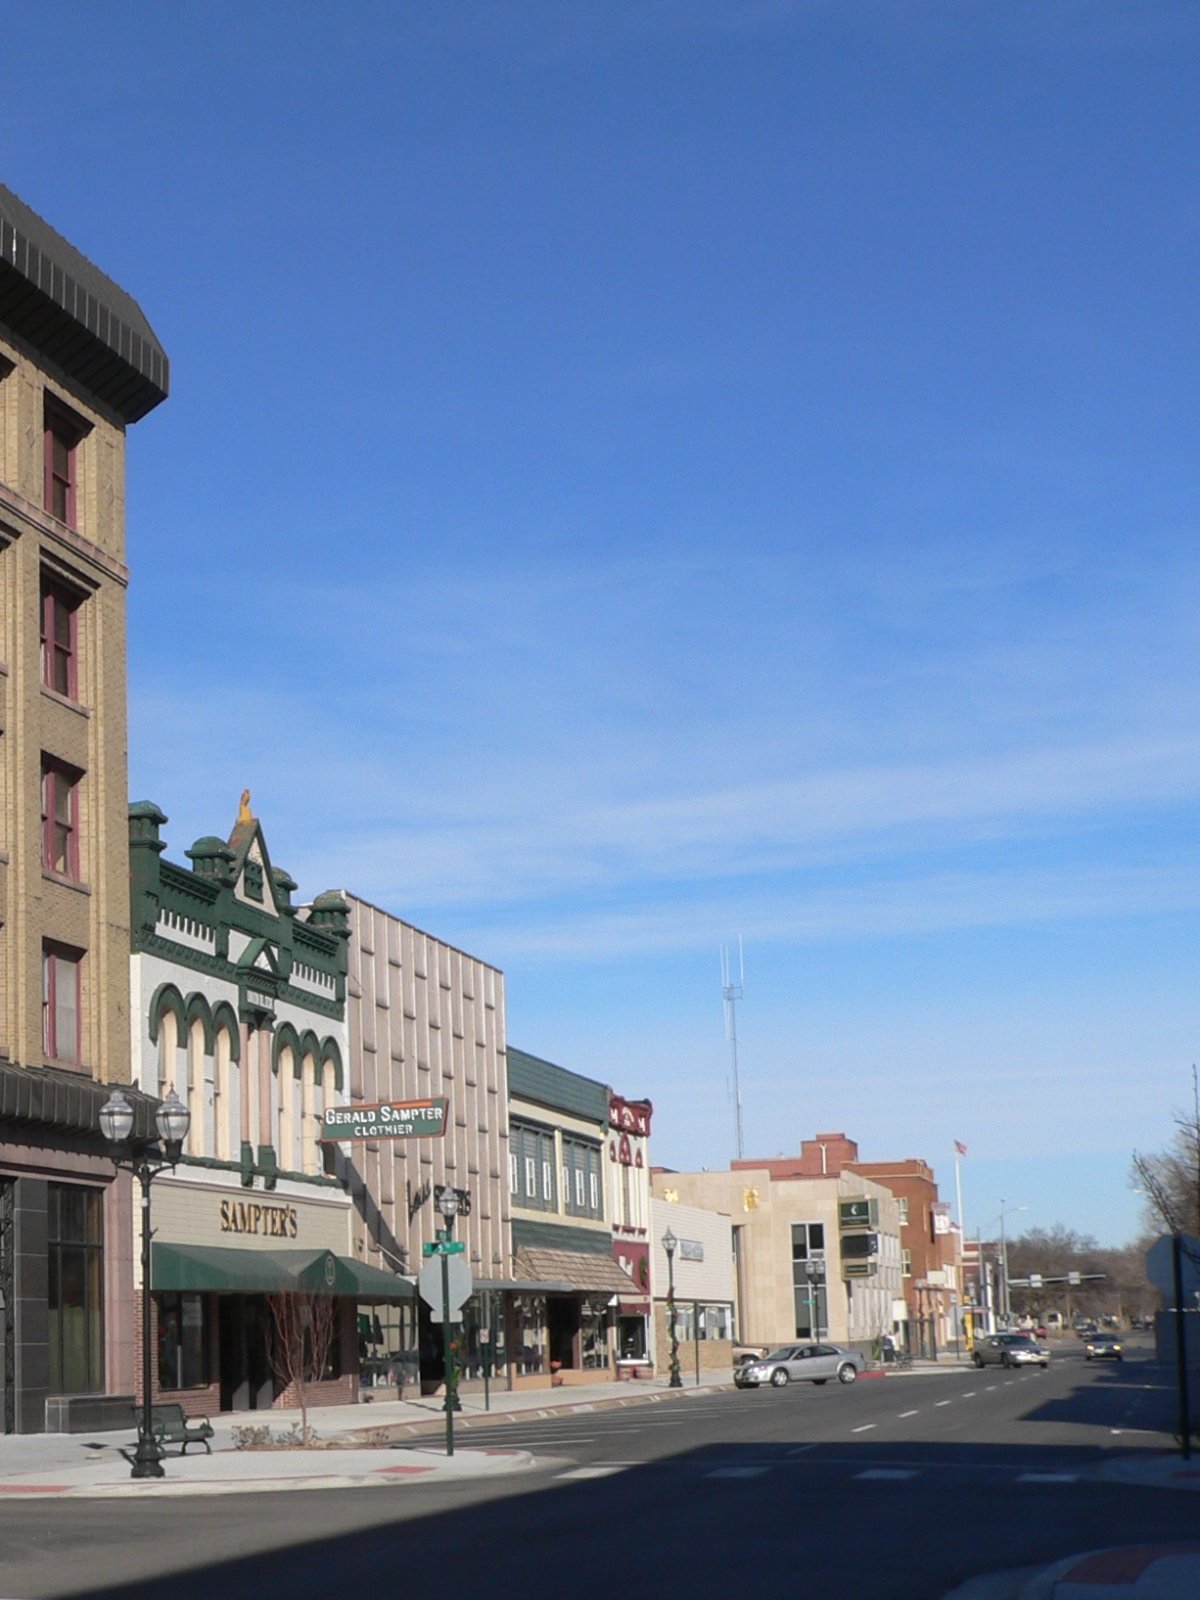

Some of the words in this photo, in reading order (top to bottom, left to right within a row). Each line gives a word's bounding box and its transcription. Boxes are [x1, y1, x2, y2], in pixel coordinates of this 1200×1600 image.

[325, 1109, 376, 1125] GERALD
[380, 1106, 443, 1122] SAMPTER
[354, 1124, 413, 1136] CLOTHIER
[220, 1199, 298, 1239] SAMPTER'S
